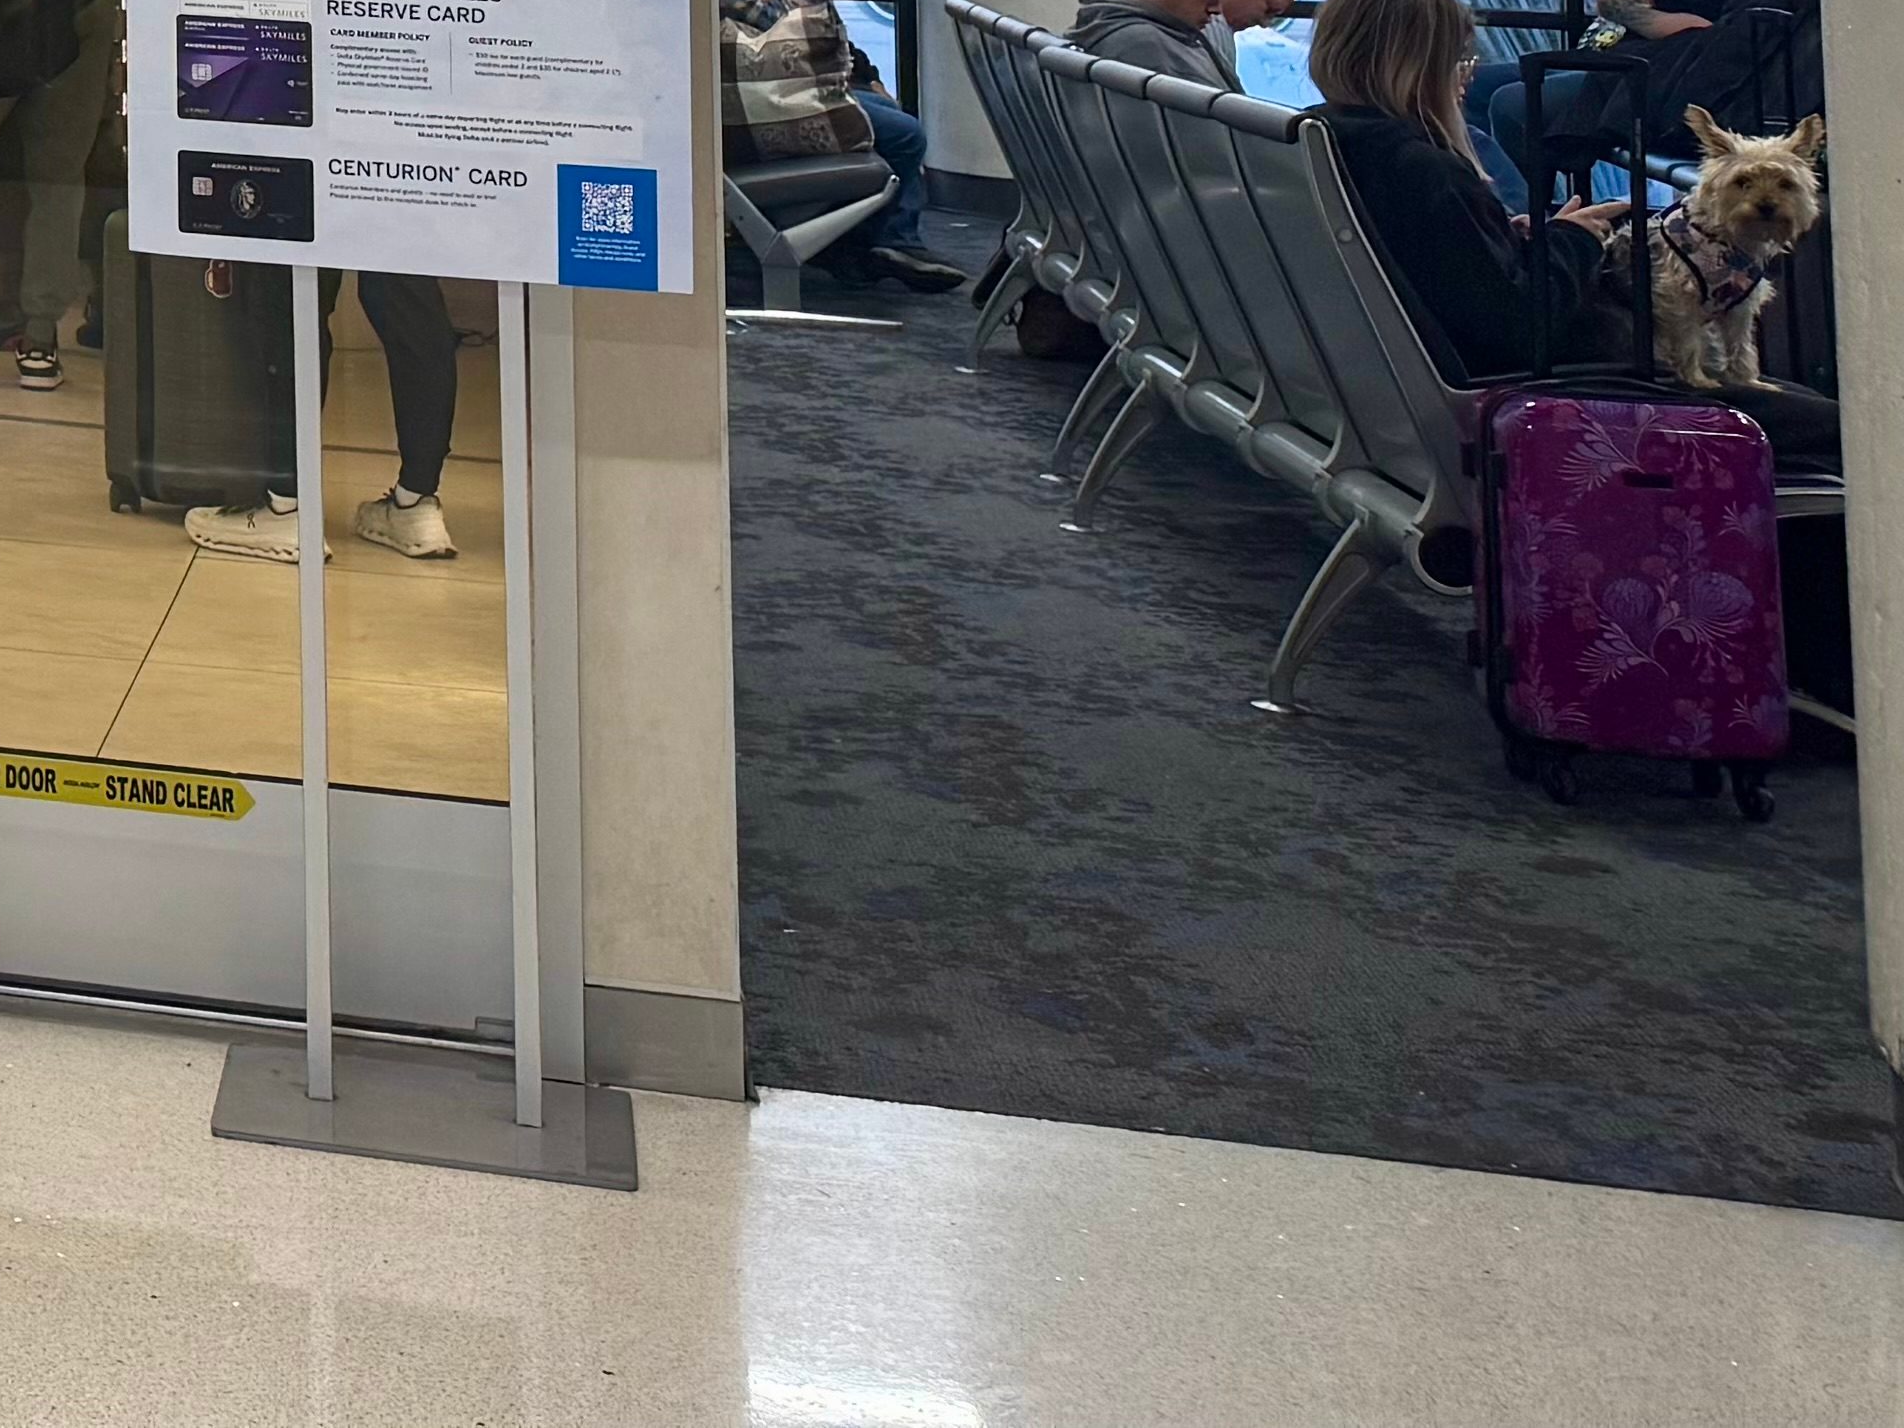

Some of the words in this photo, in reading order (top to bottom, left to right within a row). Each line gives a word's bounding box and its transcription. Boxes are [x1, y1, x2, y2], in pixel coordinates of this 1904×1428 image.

[327, 0, 421, 21] RESERVE
[427, 5, 485, 24] CARD
[469, 168, 528, 187] CARD
[6, 763, 57, 794] DOOR
[105, 775, 168, 805] STAND
[173, 782, 234, 813] CLEAR
